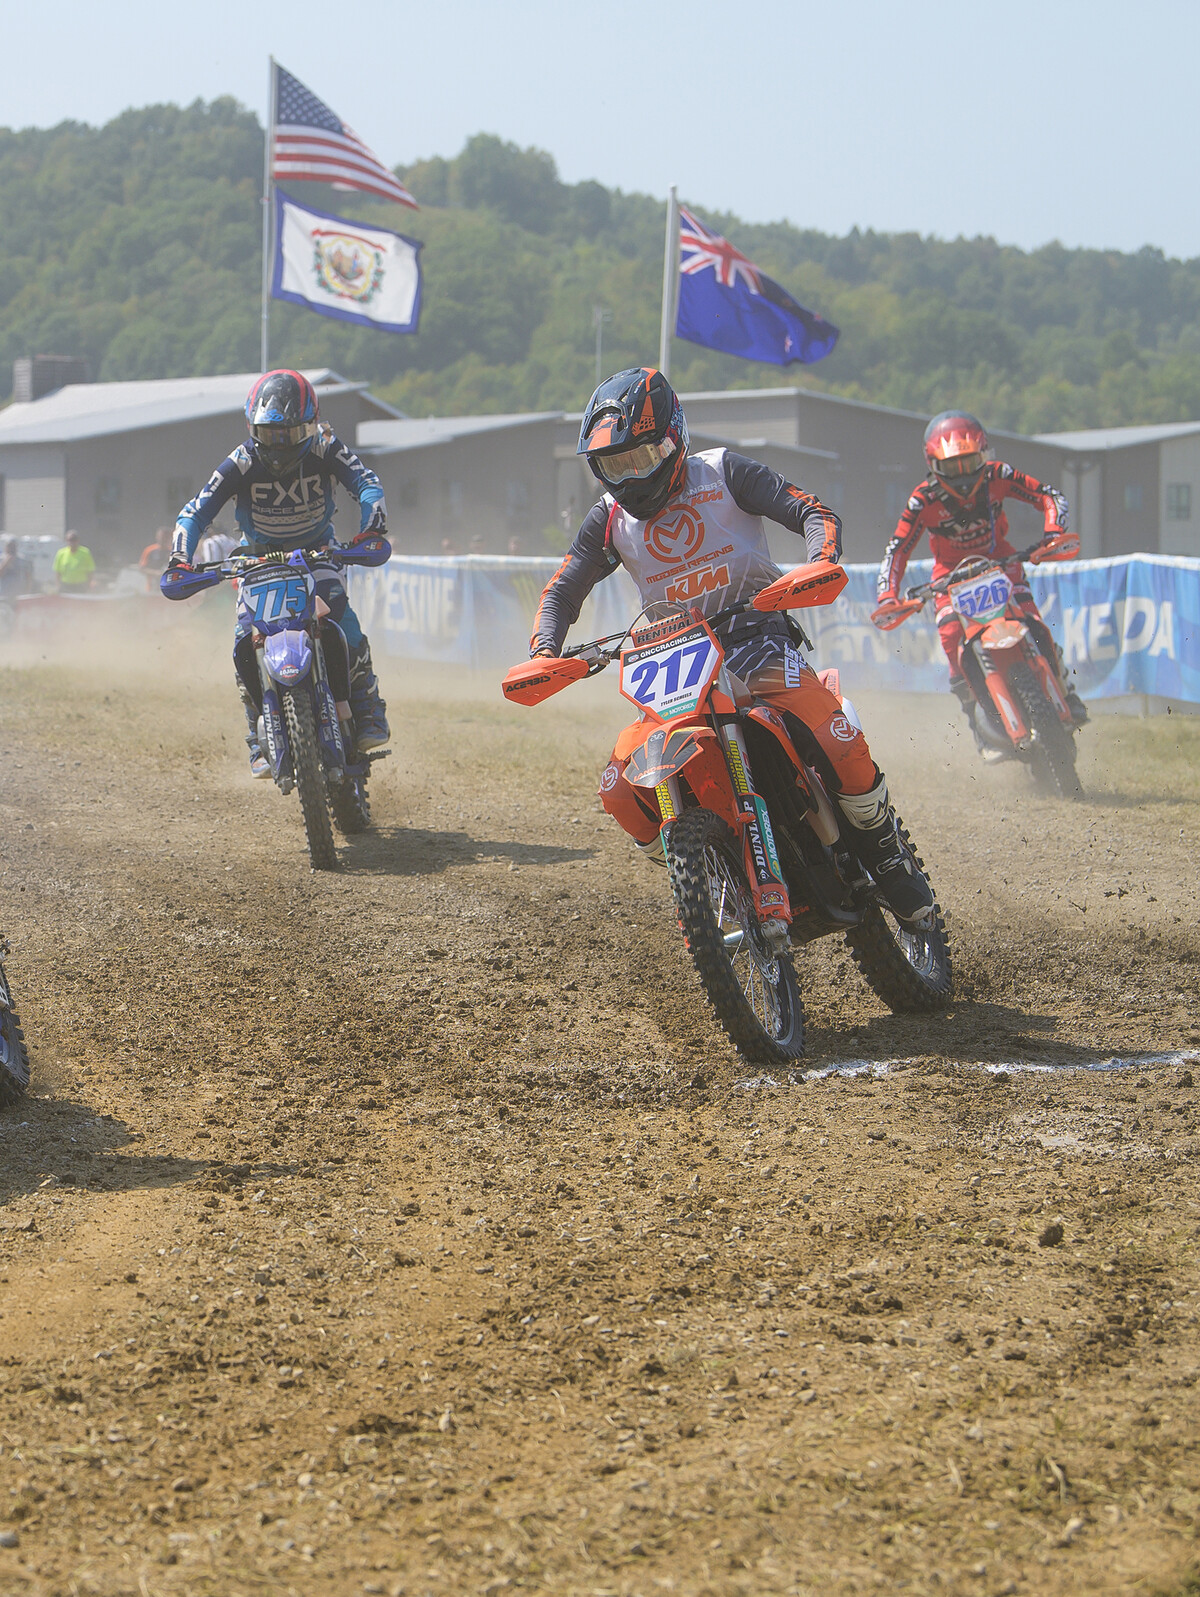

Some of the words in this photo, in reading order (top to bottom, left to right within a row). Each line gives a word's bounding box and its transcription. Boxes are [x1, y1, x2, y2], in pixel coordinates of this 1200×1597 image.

[251, 473, 325, 506] FXR
[691, 488, 724, 507] KTM
[686, 544, 735, 569] RACING
[250, 578, 308, 622] 775
[664, 563, 731, 607] KTM
[791, 572, 842, 596] ACERBIS
[957, 578, 1009, 618] 526
[636, 618, 695, 643] RENTHAL
[505, 675, 552, 693] ACERBIS
[630, 639, 712, 705] 217
[262, 703, 277, 760] DUNLOP
[326, 693, 343, 749] DUNLOP
[633, 763, 676, 783] LANDERS
[743, 800, 767, 868] DUNLP
[761, 808, 778, 860] MOTOREX
